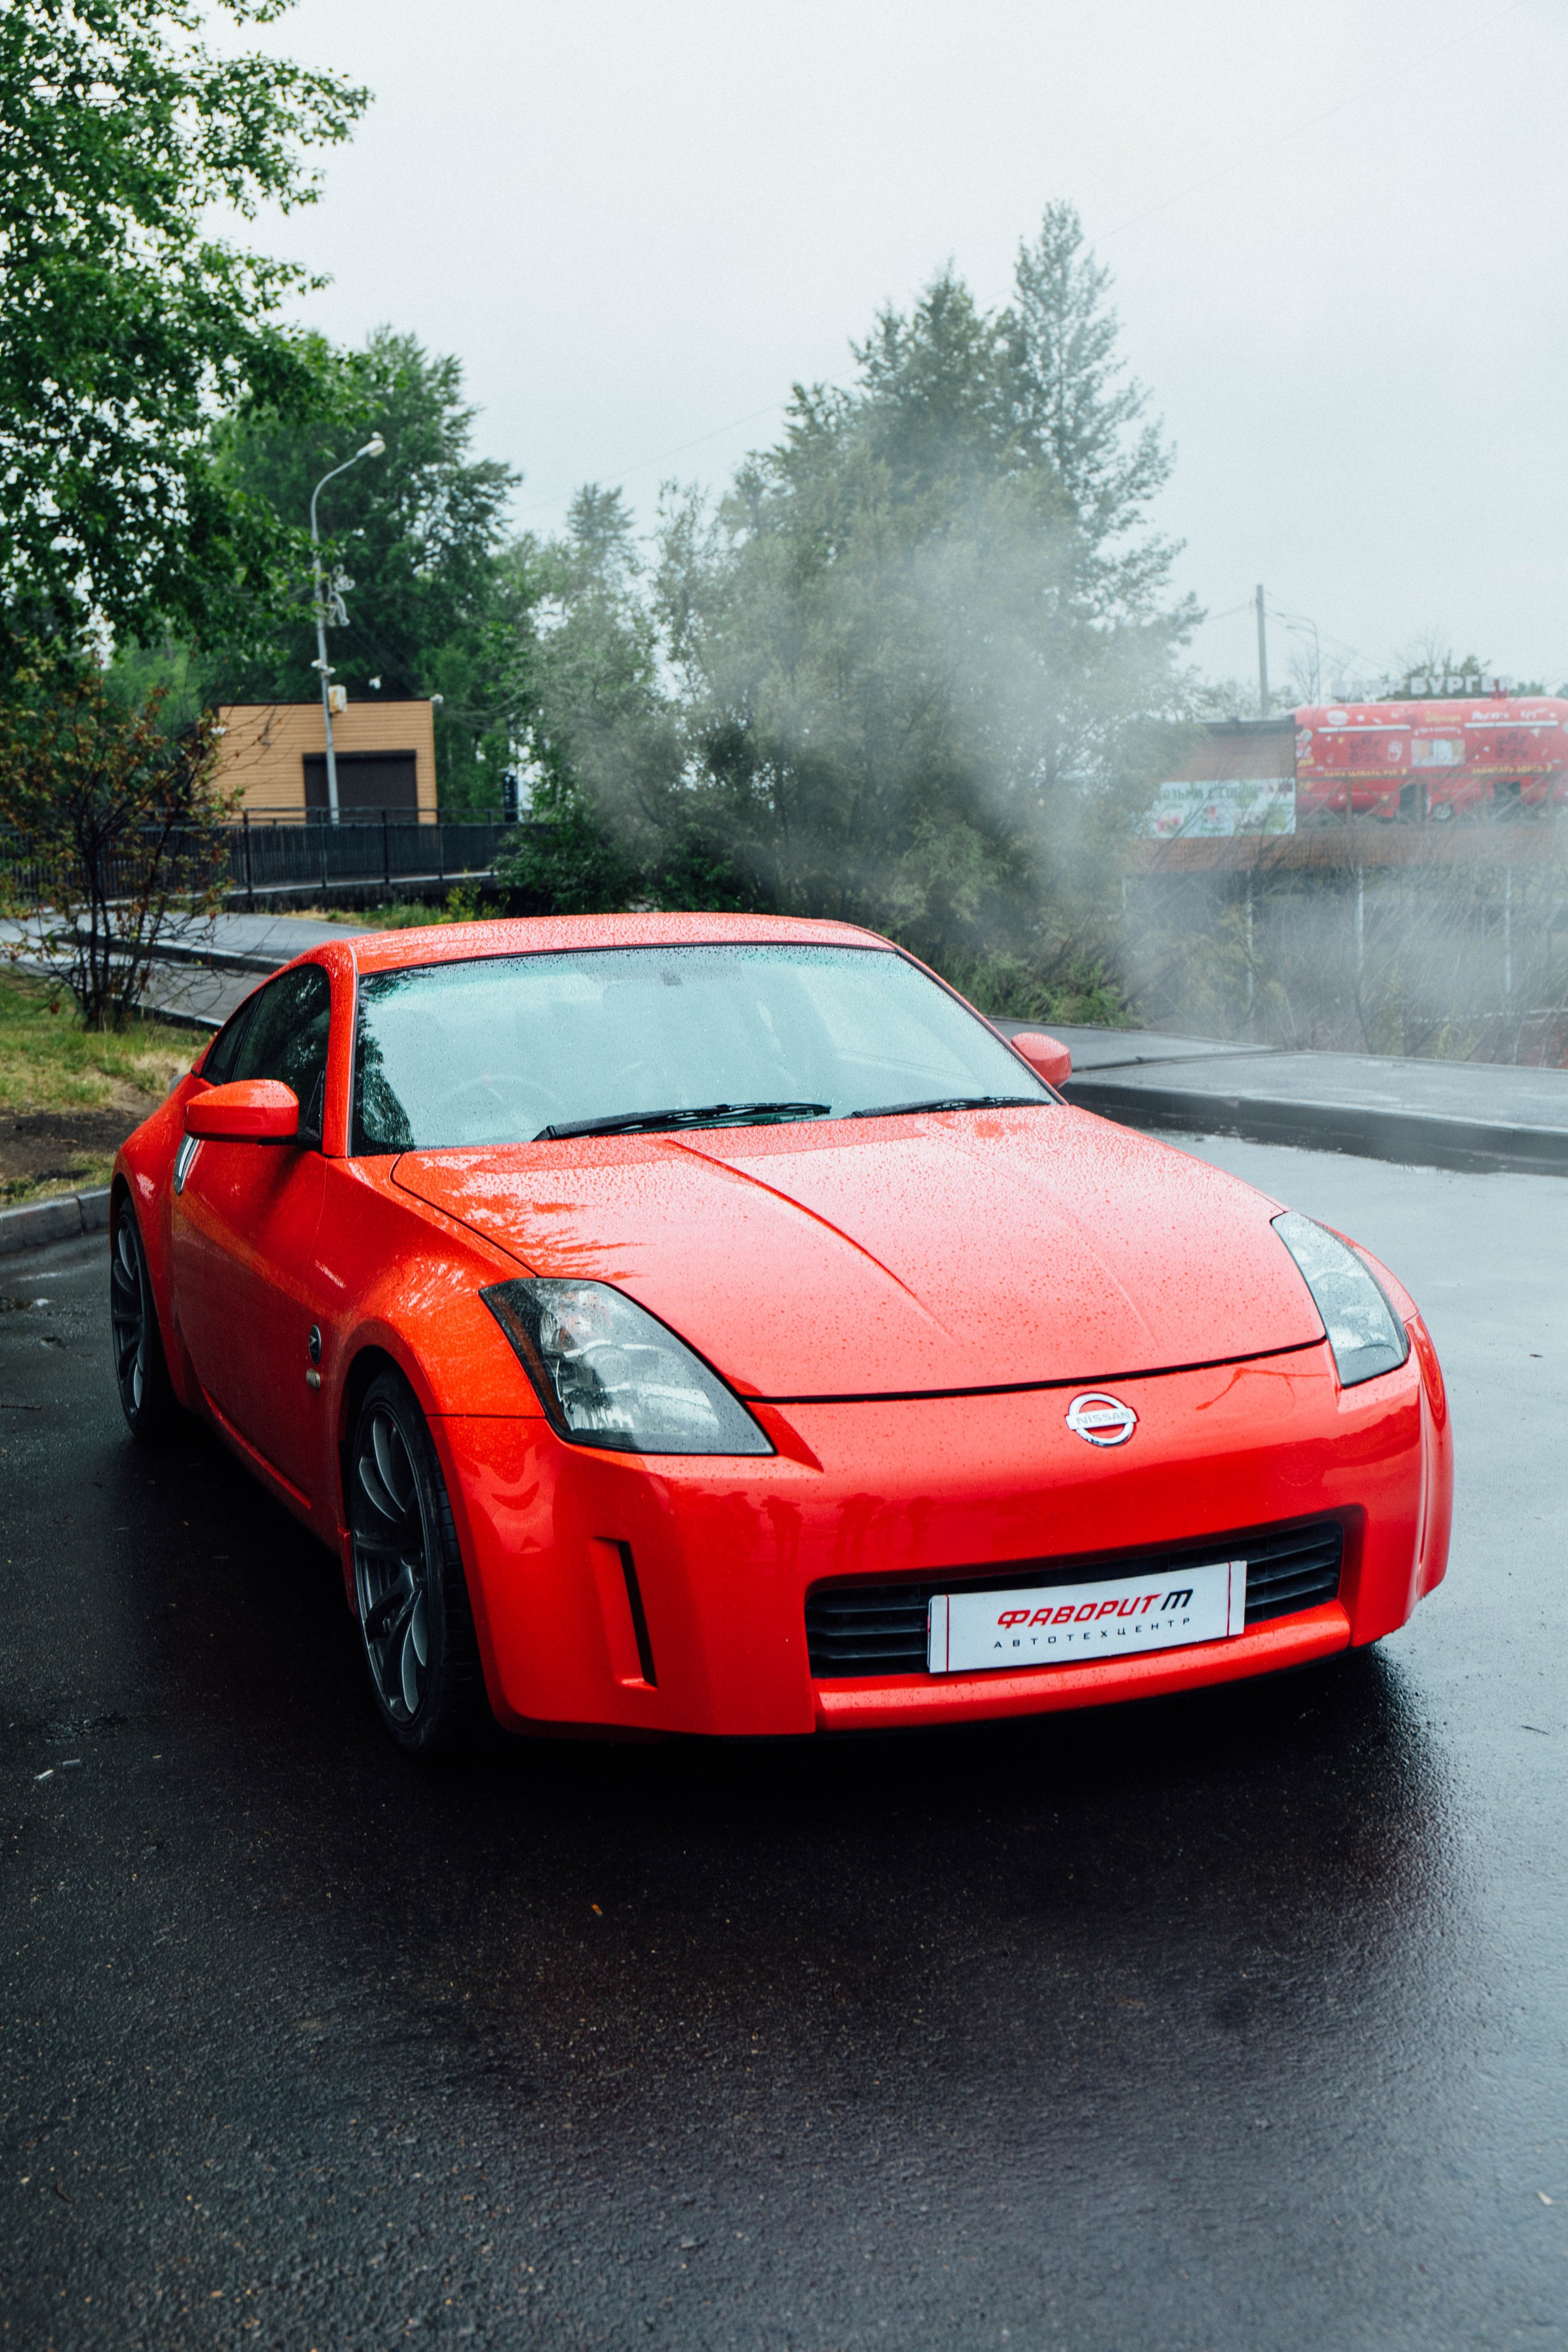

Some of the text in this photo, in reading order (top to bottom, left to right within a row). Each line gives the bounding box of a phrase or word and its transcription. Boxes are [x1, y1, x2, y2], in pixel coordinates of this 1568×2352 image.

[1163, 788, 1203, 799] ОЗЬМИ
[1076, 1411, 1130, 1425] NISSAN
[993, 1618, 1190, 1649] АВТОТЕХЦЕНТР
